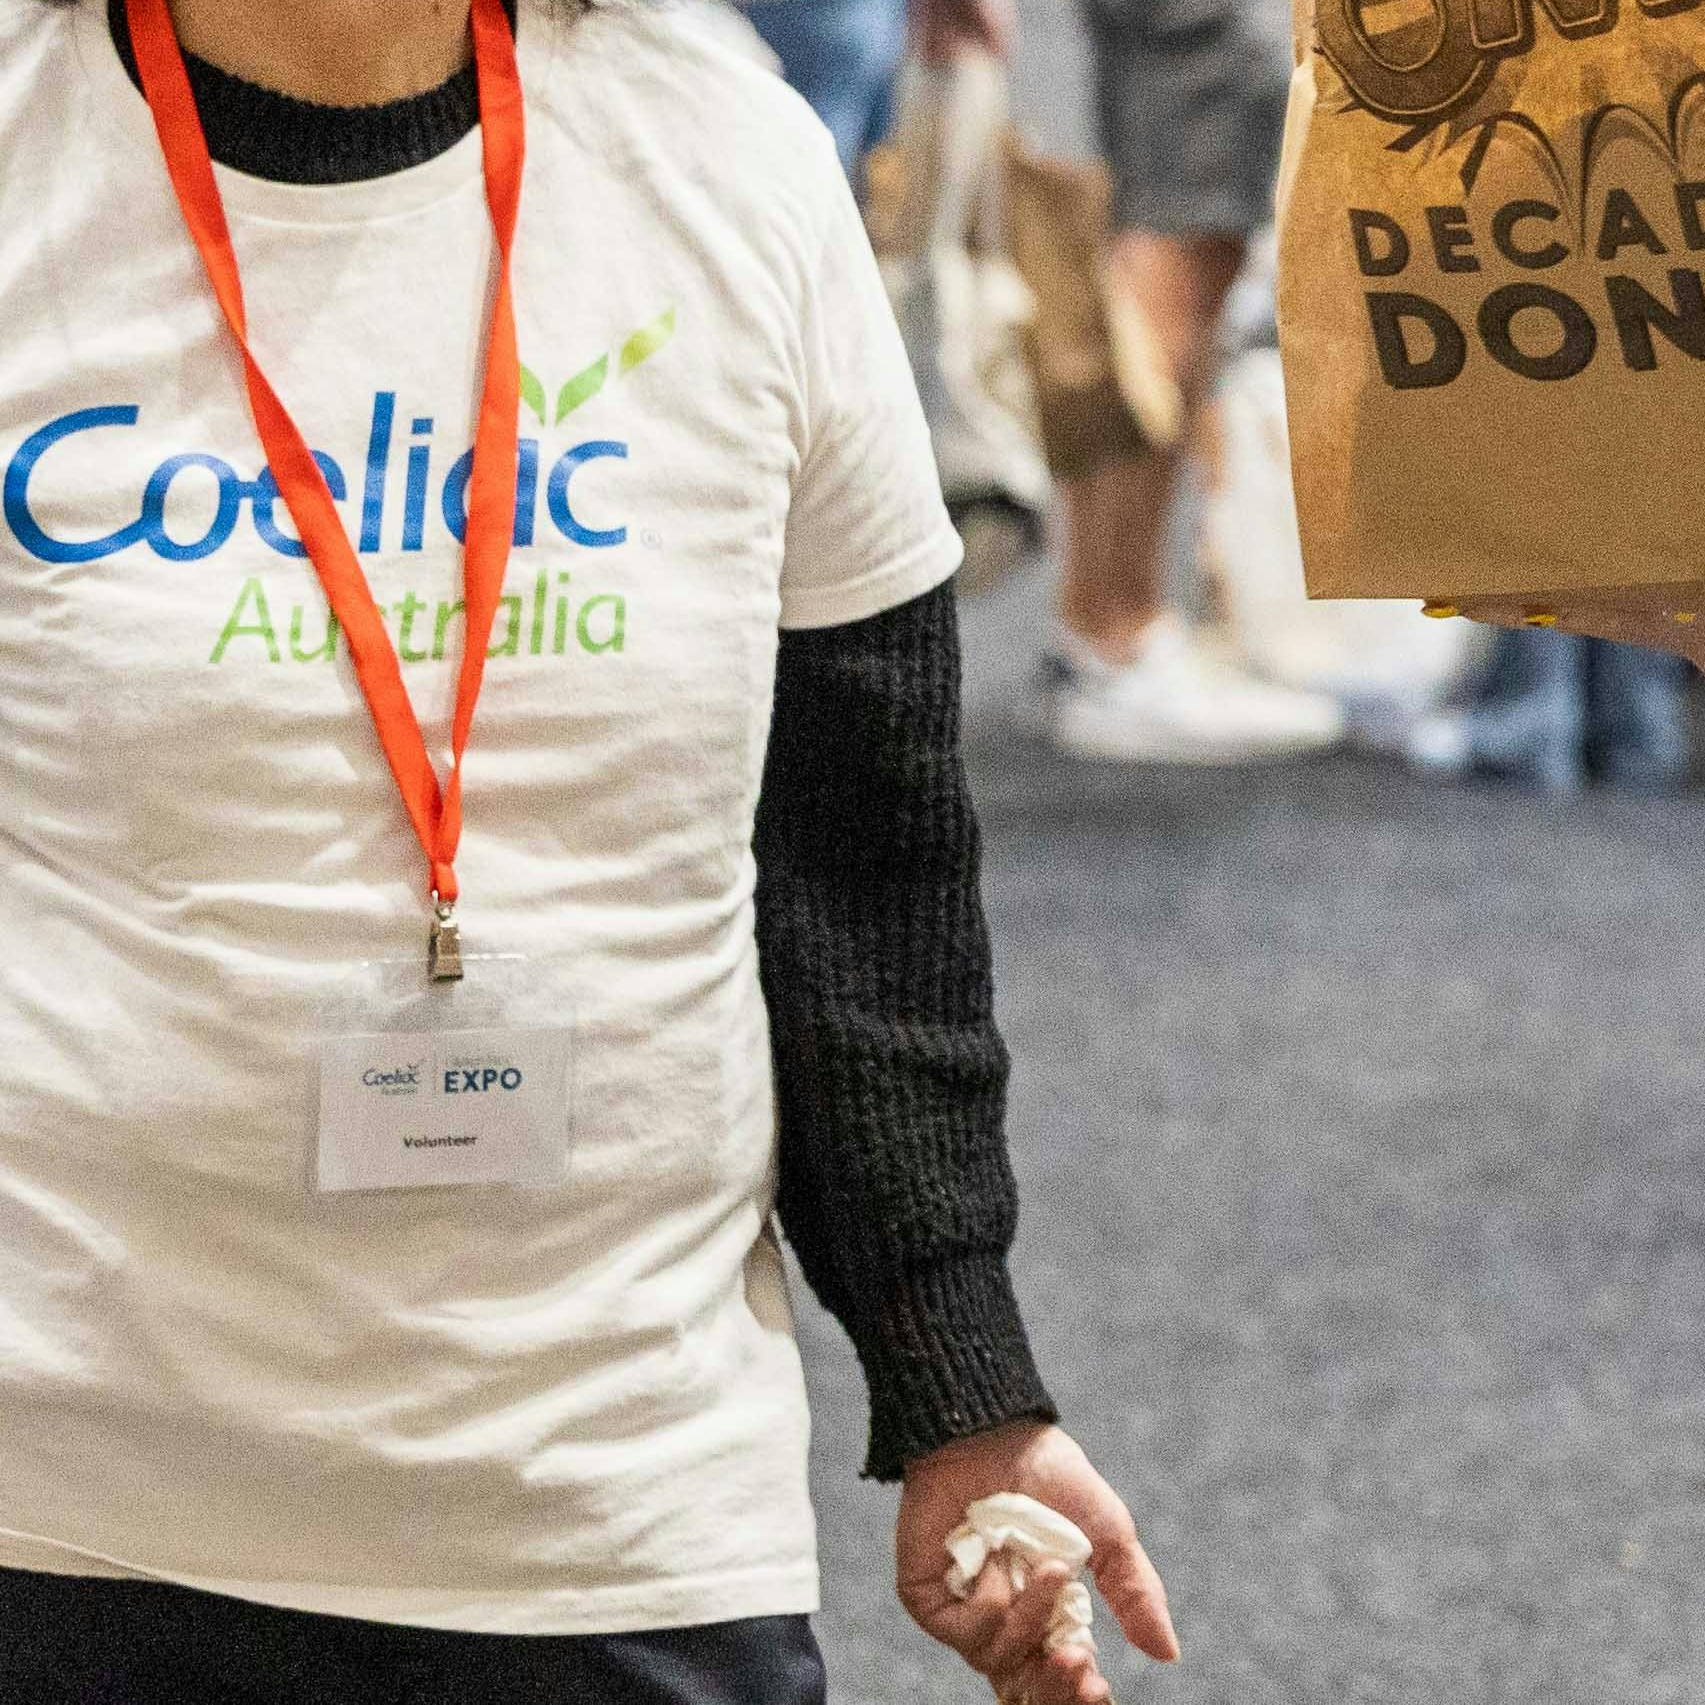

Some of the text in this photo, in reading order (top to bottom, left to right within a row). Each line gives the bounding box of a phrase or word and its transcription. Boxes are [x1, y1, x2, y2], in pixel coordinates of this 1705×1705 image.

[209, 568, 627, 665] Autralia
[444, 1067, 523, 1094] EXPO
[403, 1135, 478, 1149] Volunteer
